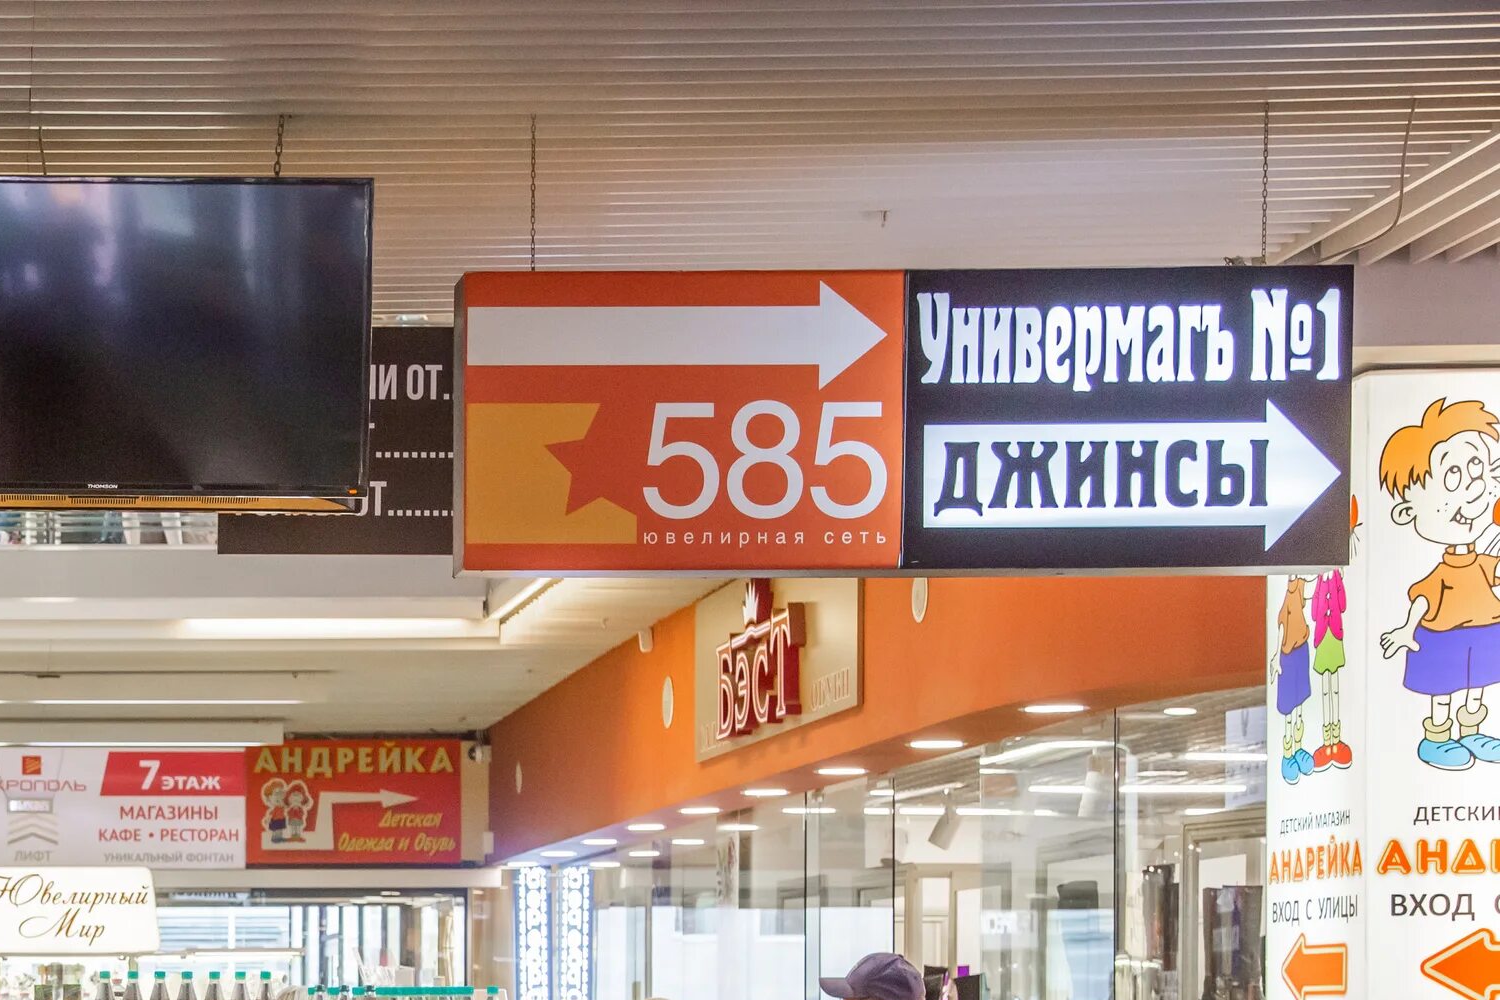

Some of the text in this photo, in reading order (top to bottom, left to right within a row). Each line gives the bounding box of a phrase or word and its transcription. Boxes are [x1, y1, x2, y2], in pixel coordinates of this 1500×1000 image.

[917, 292, 1234, 392] Универмагъ
[642, 400, 888, 519] 585
[933, 439, 1269, 517] ДЖИНСЫ
[643, 530, 887, 549] ювелирная сеть
[716, 608, 791, 739] БЭСТ
[253, 741, 454, 778] АНДРЕЙКА
[139, 760, 221, 790] 7 ЭТАЖ
[120, 805, 218, 820] МАГАЗИНЫ
[378, 810, 442, 828] Детская
[1280, 810, 1350, 836] ДЕТСКИЙ МАГАЗИН
[1413, 806, 1500, 825] ДЕТСКИ
[98, 828, 239, 841] КАФЕ РЕСТОРАН
[338, 832, 456, 856] Одежда и Обувь
[14, 850, 53, 861] ЛИФТ
[103, 850, 234, 862] УНИКАЛЬНЫЙ ФОНТАН
[1269, 835, 1362, 884] АНДРЕЙКА
[1272, 895, 1358, 926] ВХОД С УЛИЦЫ
[1390, 893, 1475, 921] ВХОД
[19, 907, 105, 946] Мир
